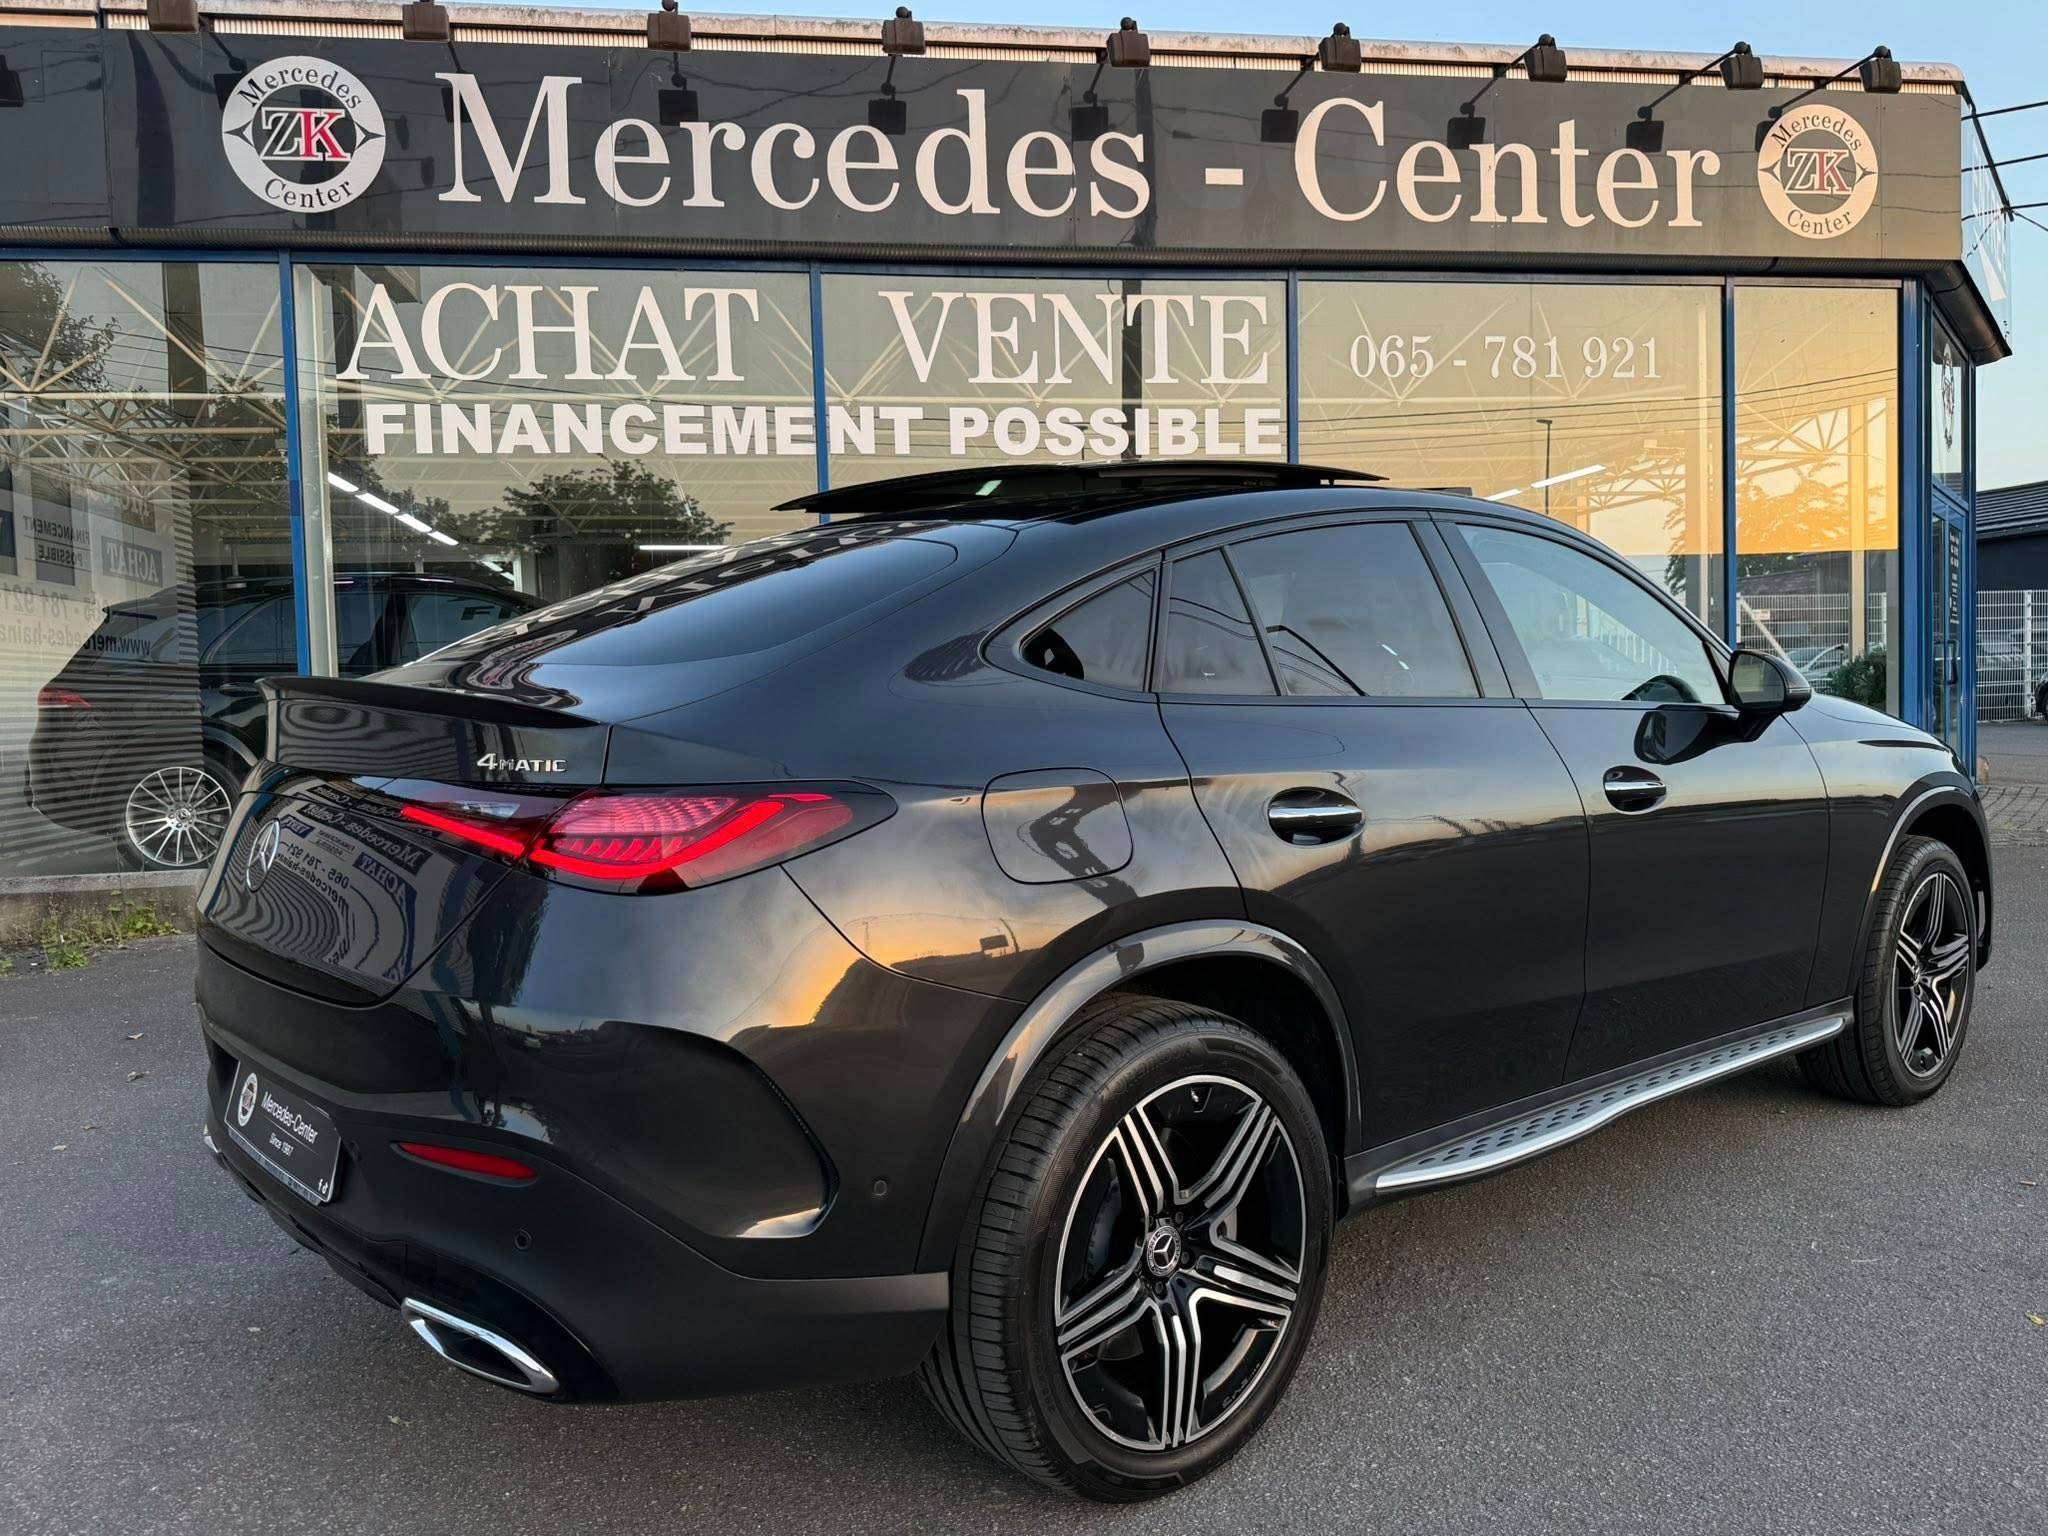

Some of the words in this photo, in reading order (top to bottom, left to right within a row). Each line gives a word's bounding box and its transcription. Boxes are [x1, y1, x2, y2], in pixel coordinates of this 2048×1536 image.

[237, 67, 361, 109] Mercedes
[260, 106, 352, 161] ZK
[435, 72, 1150, 220] Mercedes
[1294, 97, 1720, 228] Center
[1771, 114, 1861, 151] Mercedes
[265, 178, 354, 208] Center
[1785, 148, 1852, 194] ZK
[1787, 209, 1852, 235] Center
[336, 282, 760, 383] ACHAT
[878, 290, 1268, 385] VENTE
[1350, 334, 1435, 379] 065
[1483, 335, 1564, 379] 781
[1581, 336, 1661, 379] 921
[365, 403, 922, 456] FINANCEMENT
[950, 406, 1282, 457] POSSIBLE
[476, 753, 569, 772] 4MATIC
